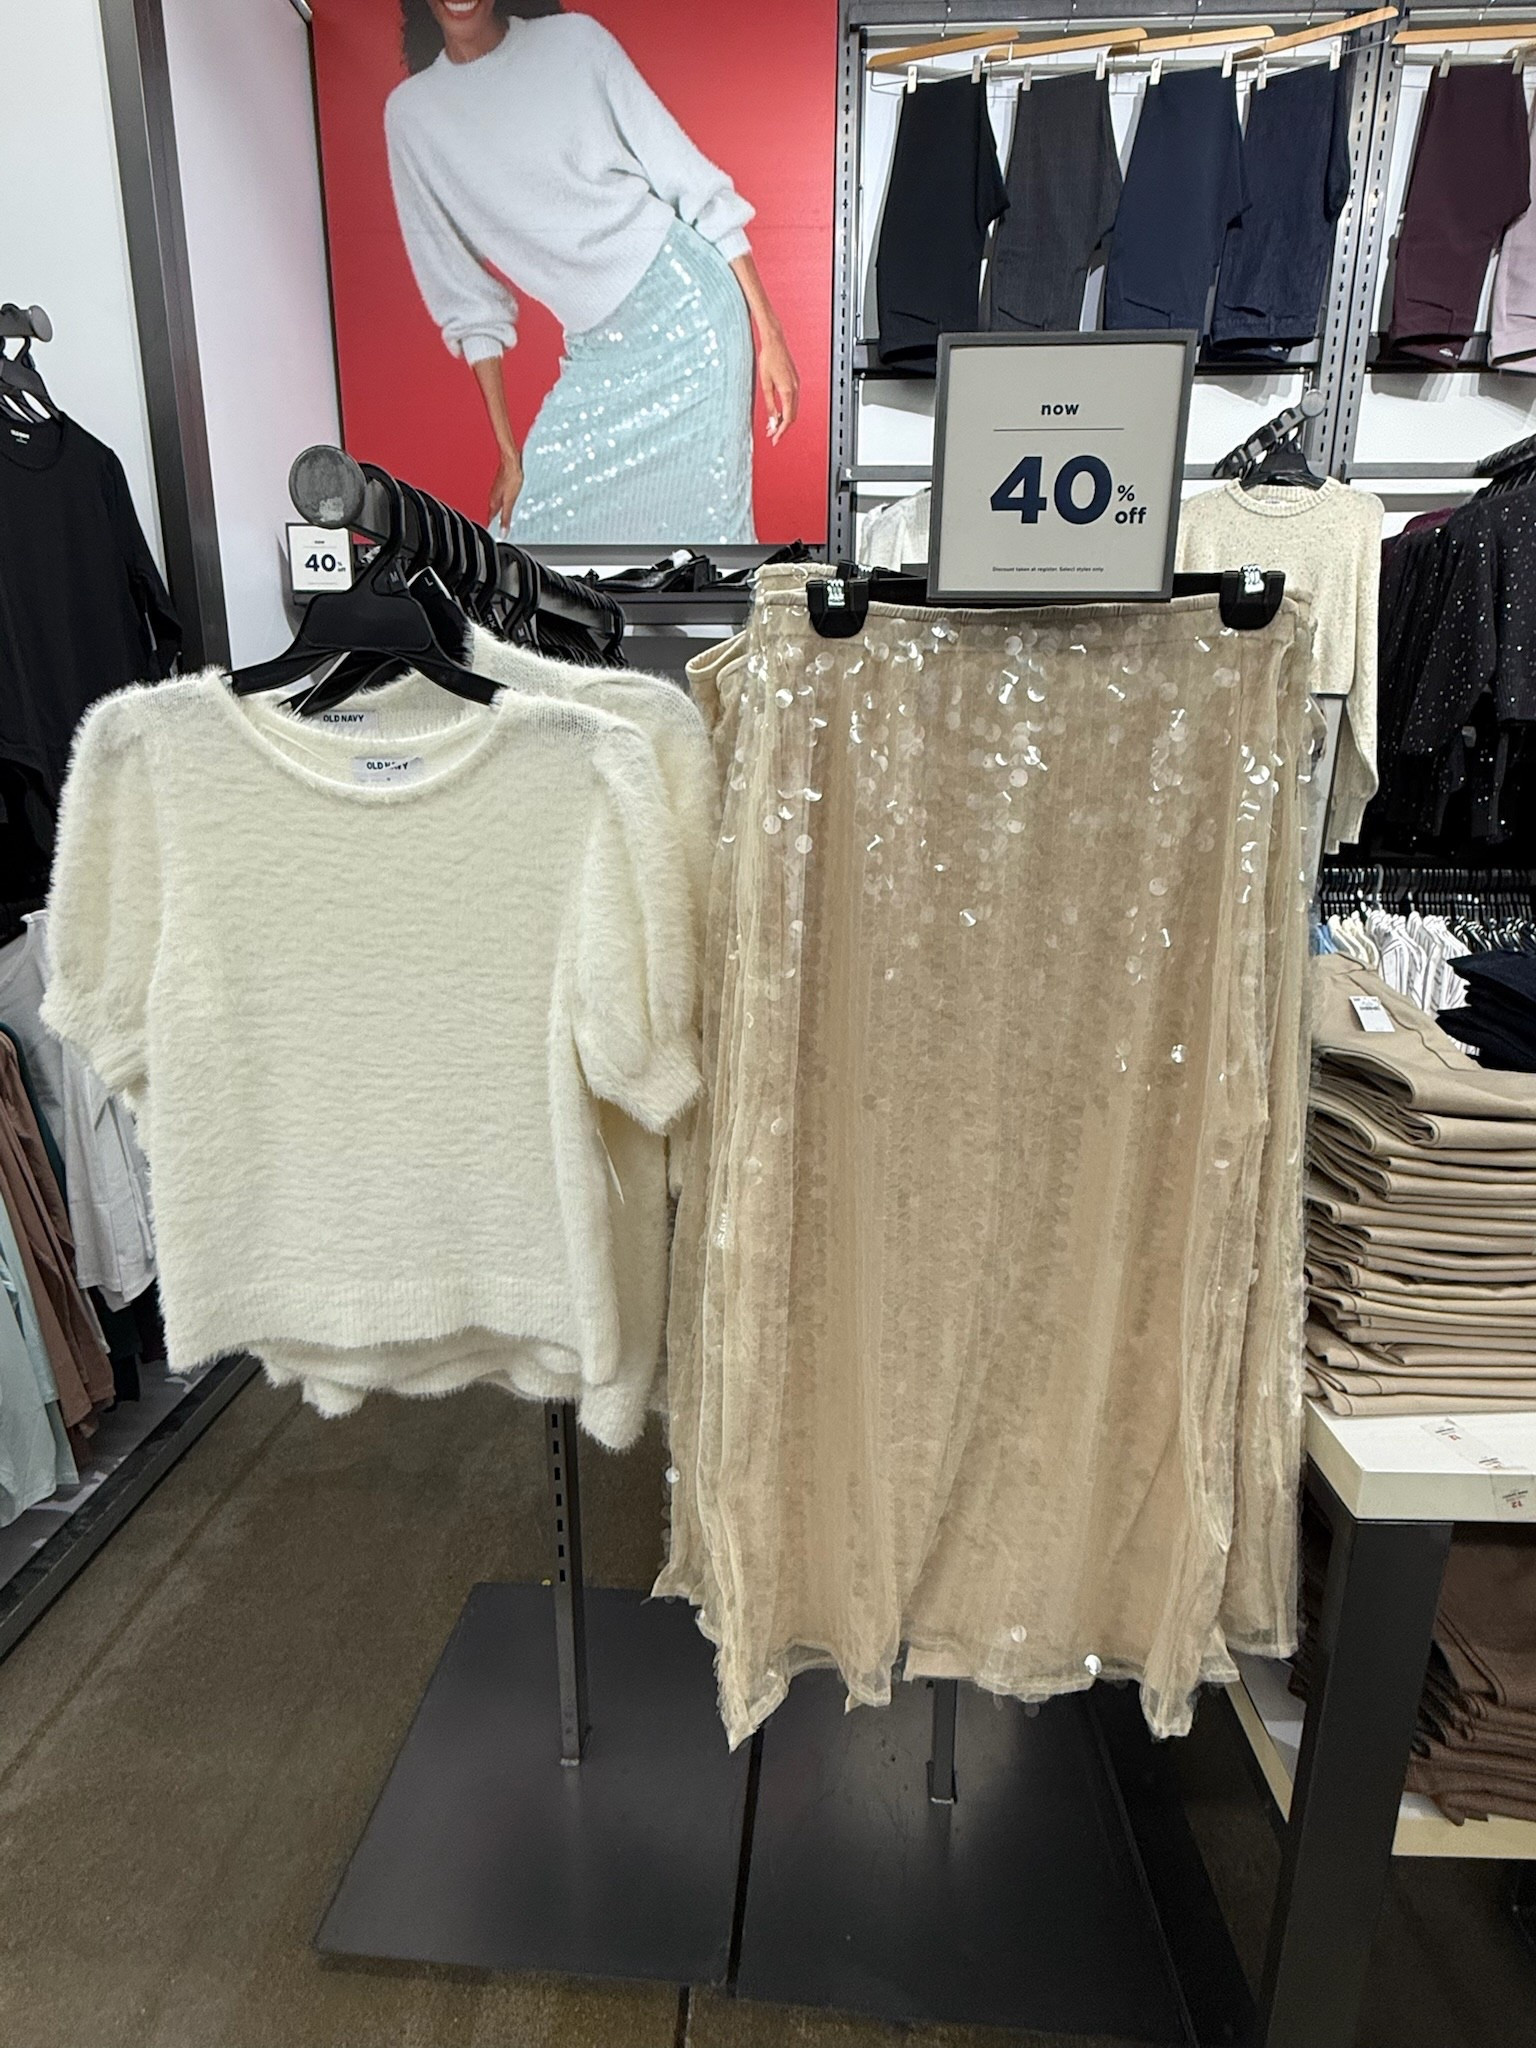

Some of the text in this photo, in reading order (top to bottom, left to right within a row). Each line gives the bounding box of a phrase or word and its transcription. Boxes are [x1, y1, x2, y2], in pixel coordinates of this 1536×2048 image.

[1041, 404, 1079, 416] now
[1115, 507, 1147, 525] off
[304, 554, 336, 572] 40
[424, 577, 434, 587] L
[323, 715, 365, 723] OLD NAVY
[366, 761, 384, 770] OLD
